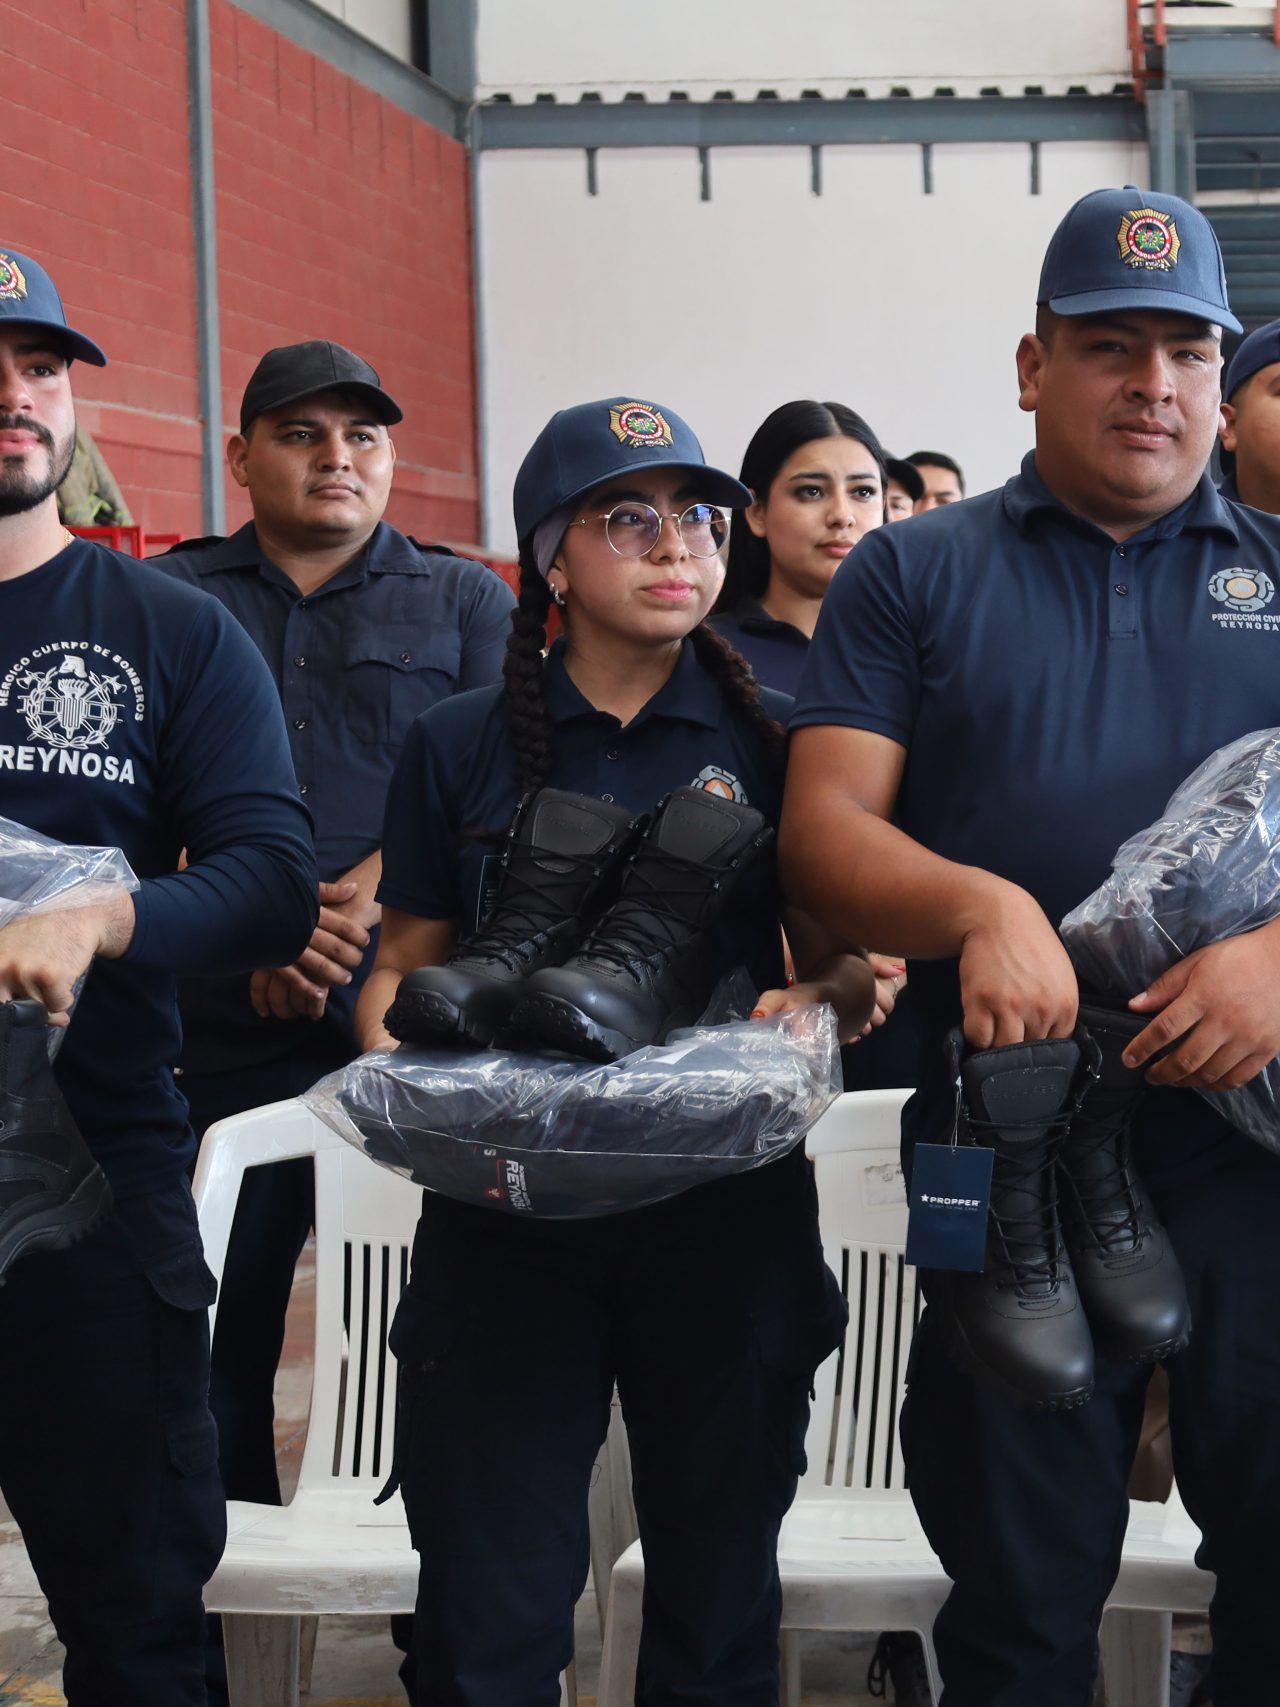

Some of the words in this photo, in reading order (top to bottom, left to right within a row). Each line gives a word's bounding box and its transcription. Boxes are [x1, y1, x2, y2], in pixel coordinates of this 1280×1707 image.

[1220, 620, 1280, 632] REYNOSA
[0, 657, 30, 707] HEROICO
[32, 641, 89, 658] CUERPO
[93, 644, 111, 658] DE
[112, 654, 145, 722] BOMBEROS
[0, 744, 135, 785] REYNOSA
[929, 1196, 980, 1207] PROPPER
